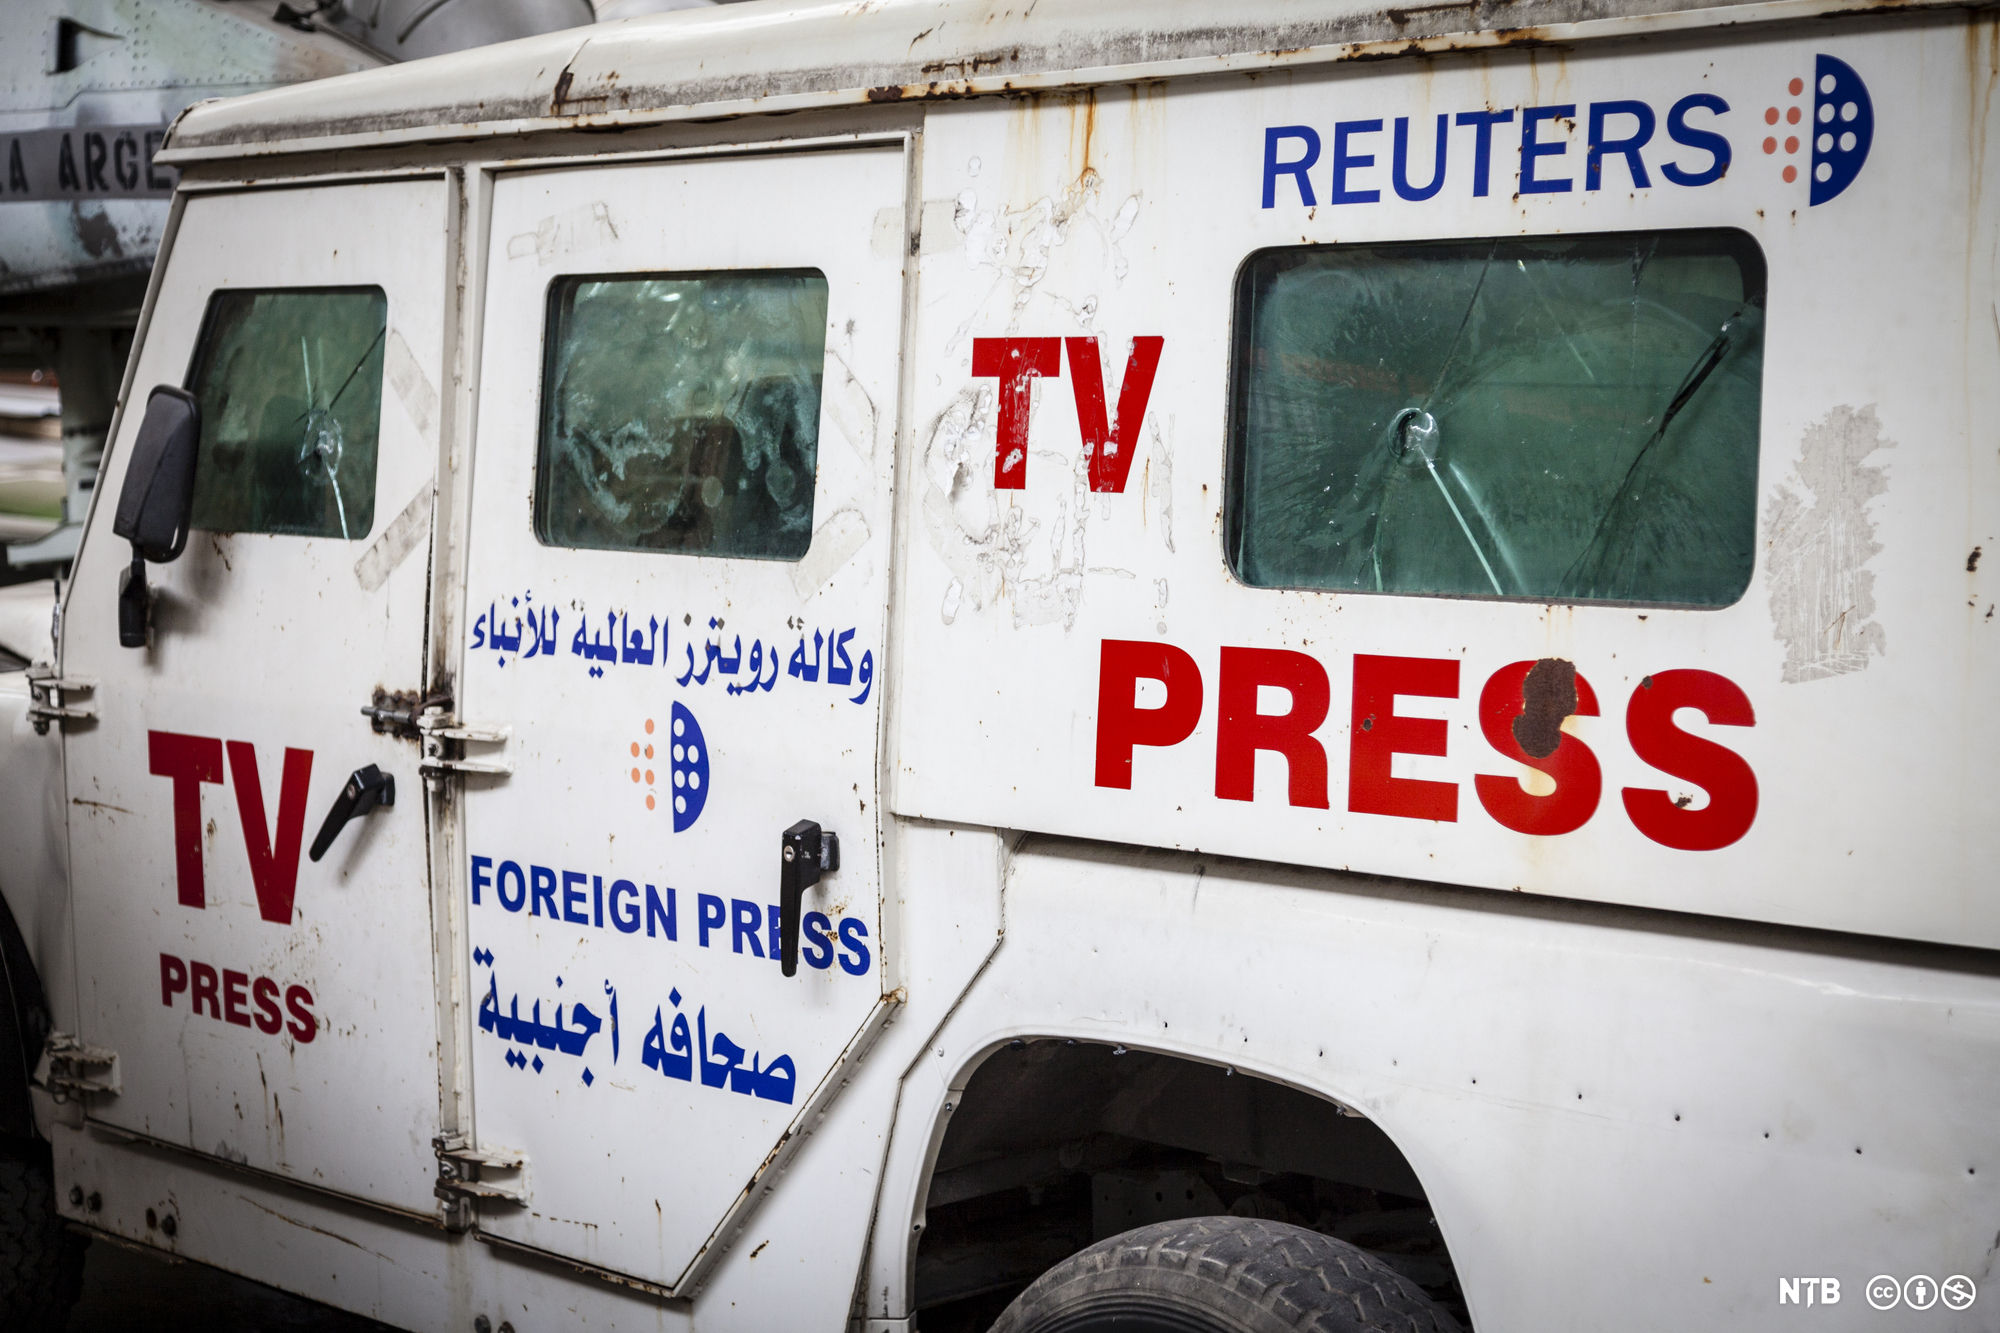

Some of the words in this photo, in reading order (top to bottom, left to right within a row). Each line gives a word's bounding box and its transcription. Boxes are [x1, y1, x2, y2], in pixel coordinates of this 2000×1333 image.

[1261, 93, 1733, 209] REUTERS
[971, 335, 1165, 494] TV
[469, 589, 560, 668] للأنباء
[571, 598, 669, 679] العالمية
[675, 612, 779, 696] رويترز
[787, 616, 874, 705] وكالة
[1094, 638, 1759, 852] PRESS
[147, 729, 314, 926] TV
[471, 854, 678, 942] FOREIGN
[159, 952, 317, 1044] PRESS
[472, 945, 620, 1088] أجنبية
